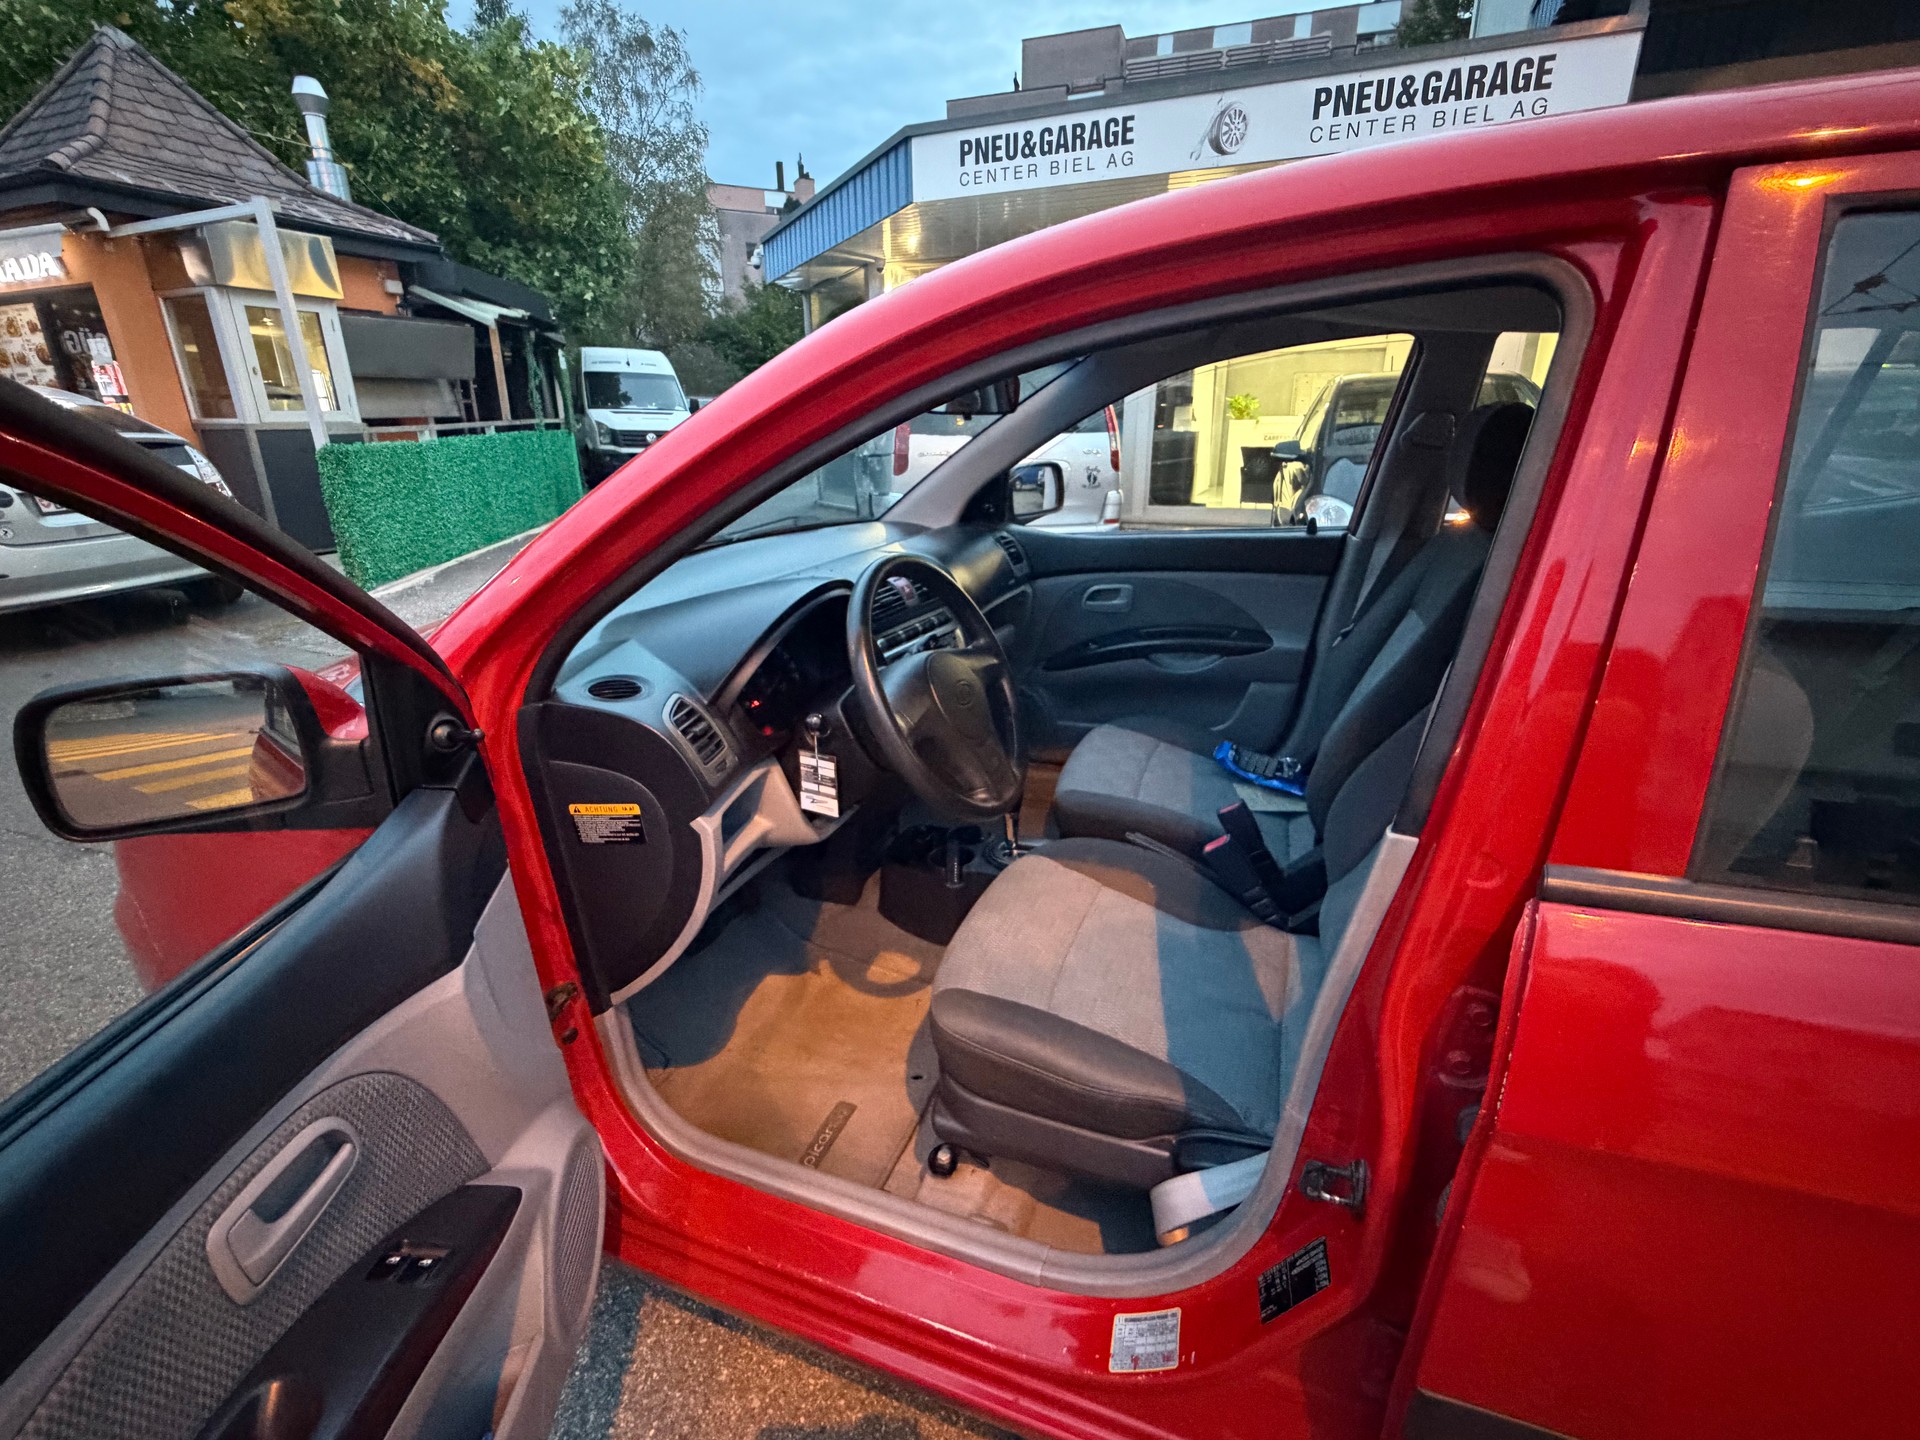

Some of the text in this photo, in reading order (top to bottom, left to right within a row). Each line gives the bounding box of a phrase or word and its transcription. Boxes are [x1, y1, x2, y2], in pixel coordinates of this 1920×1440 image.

[1312, 54, 1557, 121] PNEU&GARAGE
[959, 115, 1135, 167] PNEU&GARAGE
[1310, 97, 1548, 143] CENTER BIEL AG
[959, 150, 1134, 187] CENTER BIEL AG
[0, 252, 61, 283] ADA
